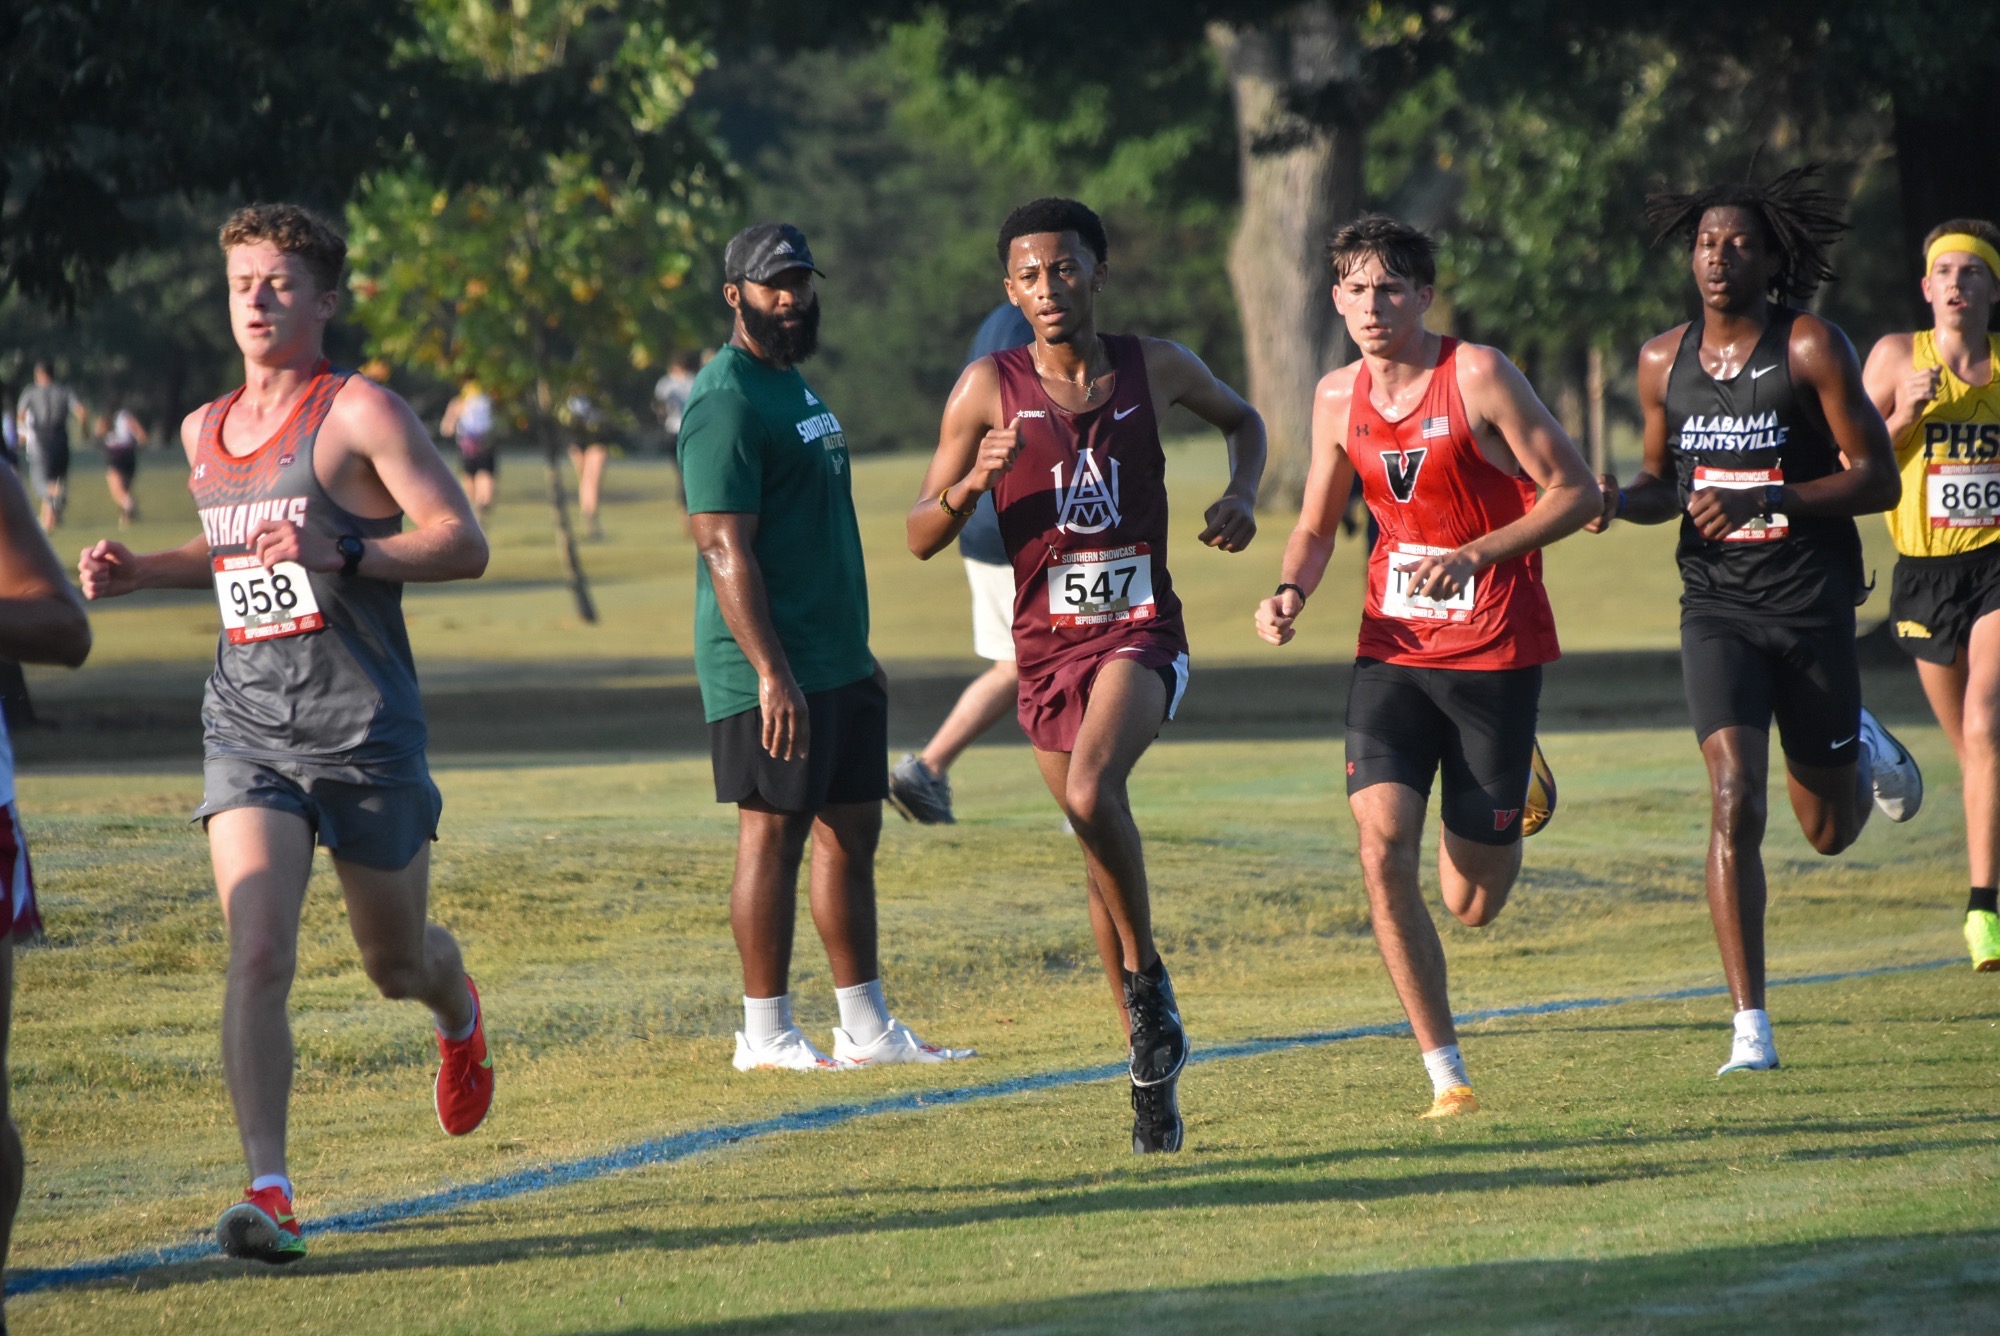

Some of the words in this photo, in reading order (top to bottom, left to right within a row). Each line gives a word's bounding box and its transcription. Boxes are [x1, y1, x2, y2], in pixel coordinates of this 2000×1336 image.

[1024, 410, 1046, 418] SWAC
[1682, 410, 1779, 433] ALABAMA
[796, 414, 826, 444] SOUTH
[1679, 426, 1790, 452] HUNTSVILLE
[1924, 422, 2000, 459] PHS
[1380, 447, 1428, 503] V
[1734, 470, 1770, 482] SHOWCASE
[1942, 481, 2000, 510] 866
[1062, 550, 1098, 564] SOUTHERN
[1100, 545, 1137, 560] SHOWCASE
[230, 574, 298, 617] 958
[1065, 566, 1137, 606] 547
[1075, 614, 1107, 625] SEPTEMBER
[1493, 808, 1520, 831] V
